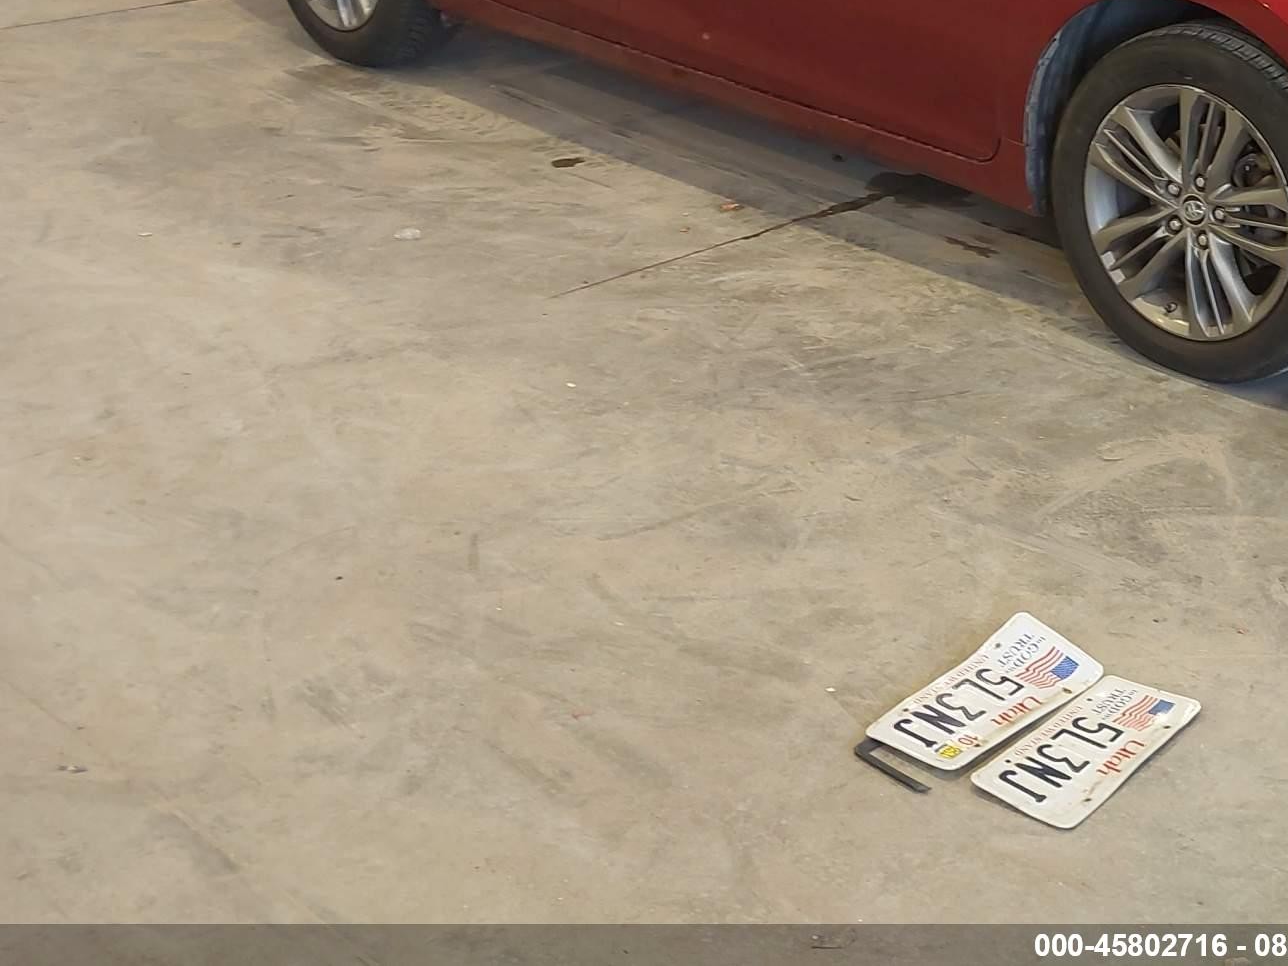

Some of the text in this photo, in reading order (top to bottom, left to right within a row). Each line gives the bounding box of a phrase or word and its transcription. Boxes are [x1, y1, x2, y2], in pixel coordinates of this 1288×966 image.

[997, 633, 1035, 668] TRUST
[1013, 642, 1039, 667] GOD
[893, 668, 1025, 749] 5L3NJ
[991, 696, 1042, 725] Utah
[1091, 688, 1126, 714] TRUST
[1108, 694, 1132, 714] GOD
[998, 716, 1126, 803] 5L3NJ
[1096, 739, 1145, 775] Utah
